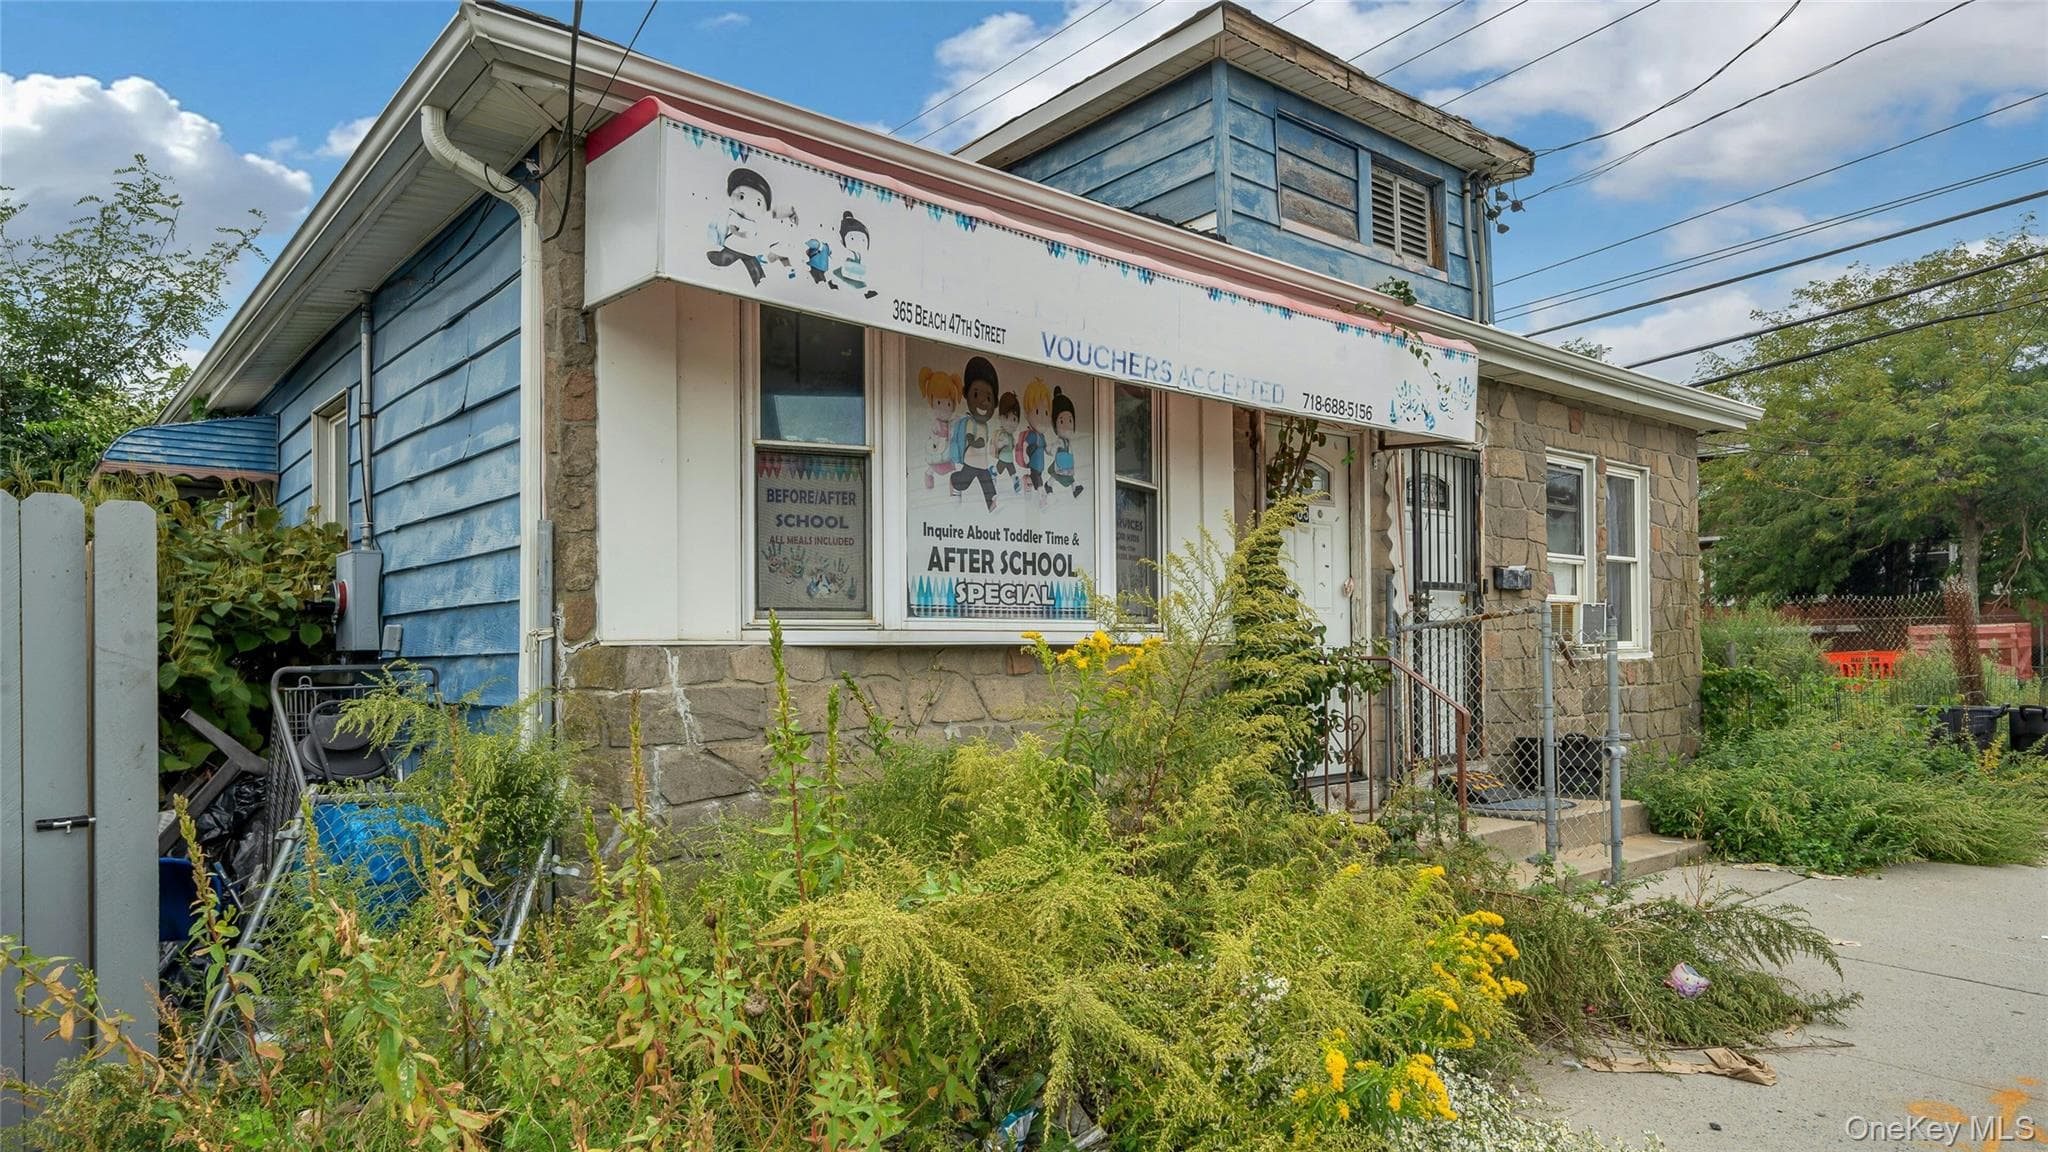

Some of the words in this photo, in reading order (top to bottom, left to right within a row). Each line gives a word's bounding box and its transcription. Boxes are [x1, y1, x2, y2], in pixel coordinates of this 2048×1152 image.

[892, 299, 913, 324] 365
[915, 304, 947, 332] BEACH
[949, 313, 972, 337] 47TH
[974, 319, 1007, 345] STREET
[1040, 332, 1172, 384] VOUCHERS
[1178, 365, 1285, 405] ACCEPTED
[1302, 392, 1373, 421] 718-688-5156
[766, 488, 857, 506] BEFORE/AFTER
[776, 513, 849, 529] SCHOOL
[922, 521, 964, 541] Inquire
[966, 525, 1000, 541] About
[1003, 528, 1043, 544] Toddler
[1045, 531, 1070, 546] Time
[1072, 532, 1080, 546] &
[769, 535, 785, 545] ALL
[786, 536, 812, 545] MEALS
[814, 537, 855, 546] INCLUDED
[927, 546, 995, 574] AFTER
[1000, 550, 1078, 578] SCHOOL
[954, 581, 1056, 606] SPECIAL
